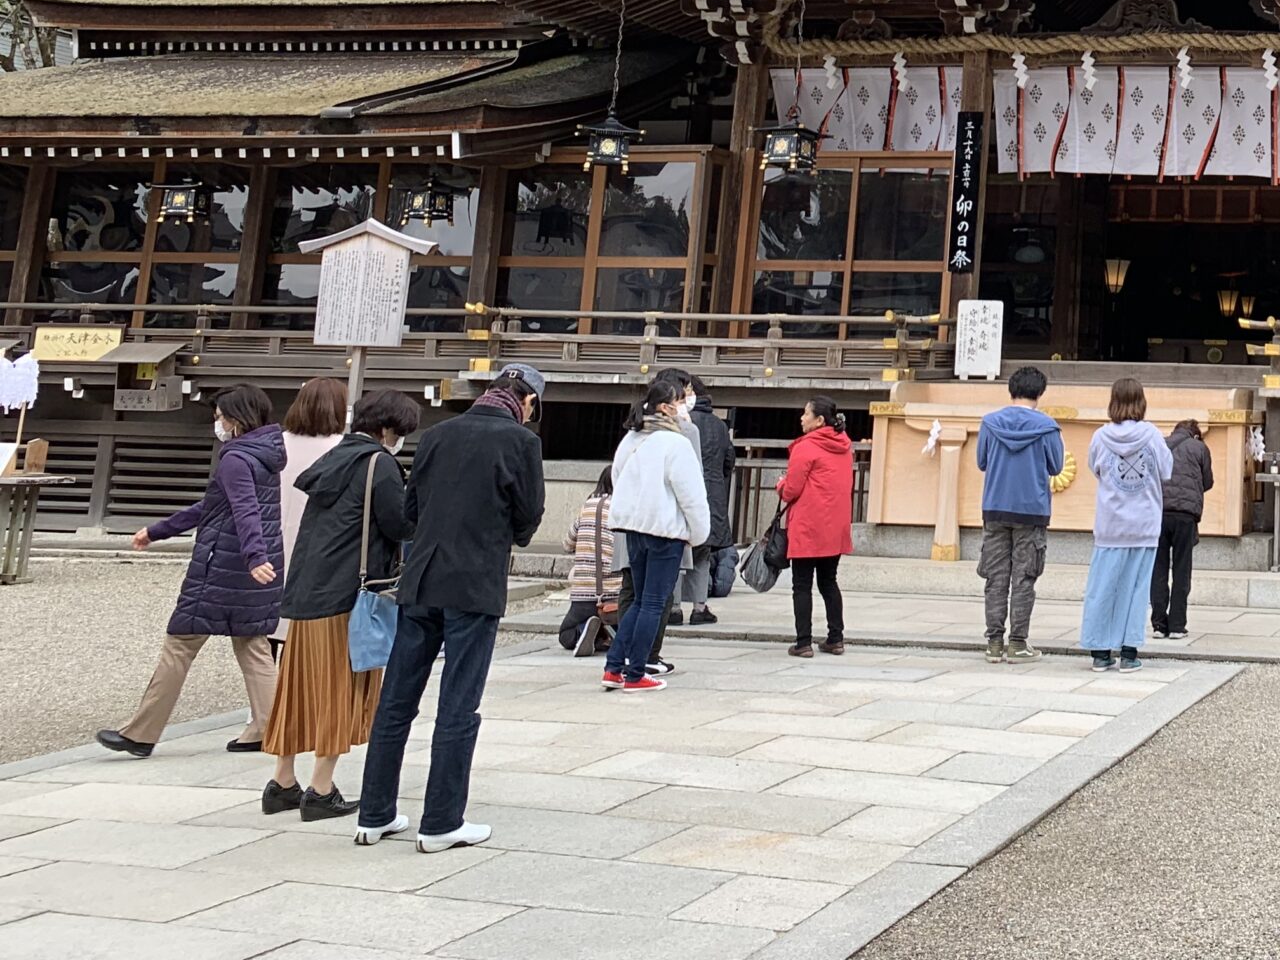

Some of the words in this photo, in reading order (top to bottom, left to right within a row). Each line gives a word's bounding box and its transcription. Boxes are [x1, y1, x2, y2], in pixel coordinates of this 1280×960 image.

[963, 121, 975, 160] 三月十九日
[950, 193, 973, 269] 卯の日祭
